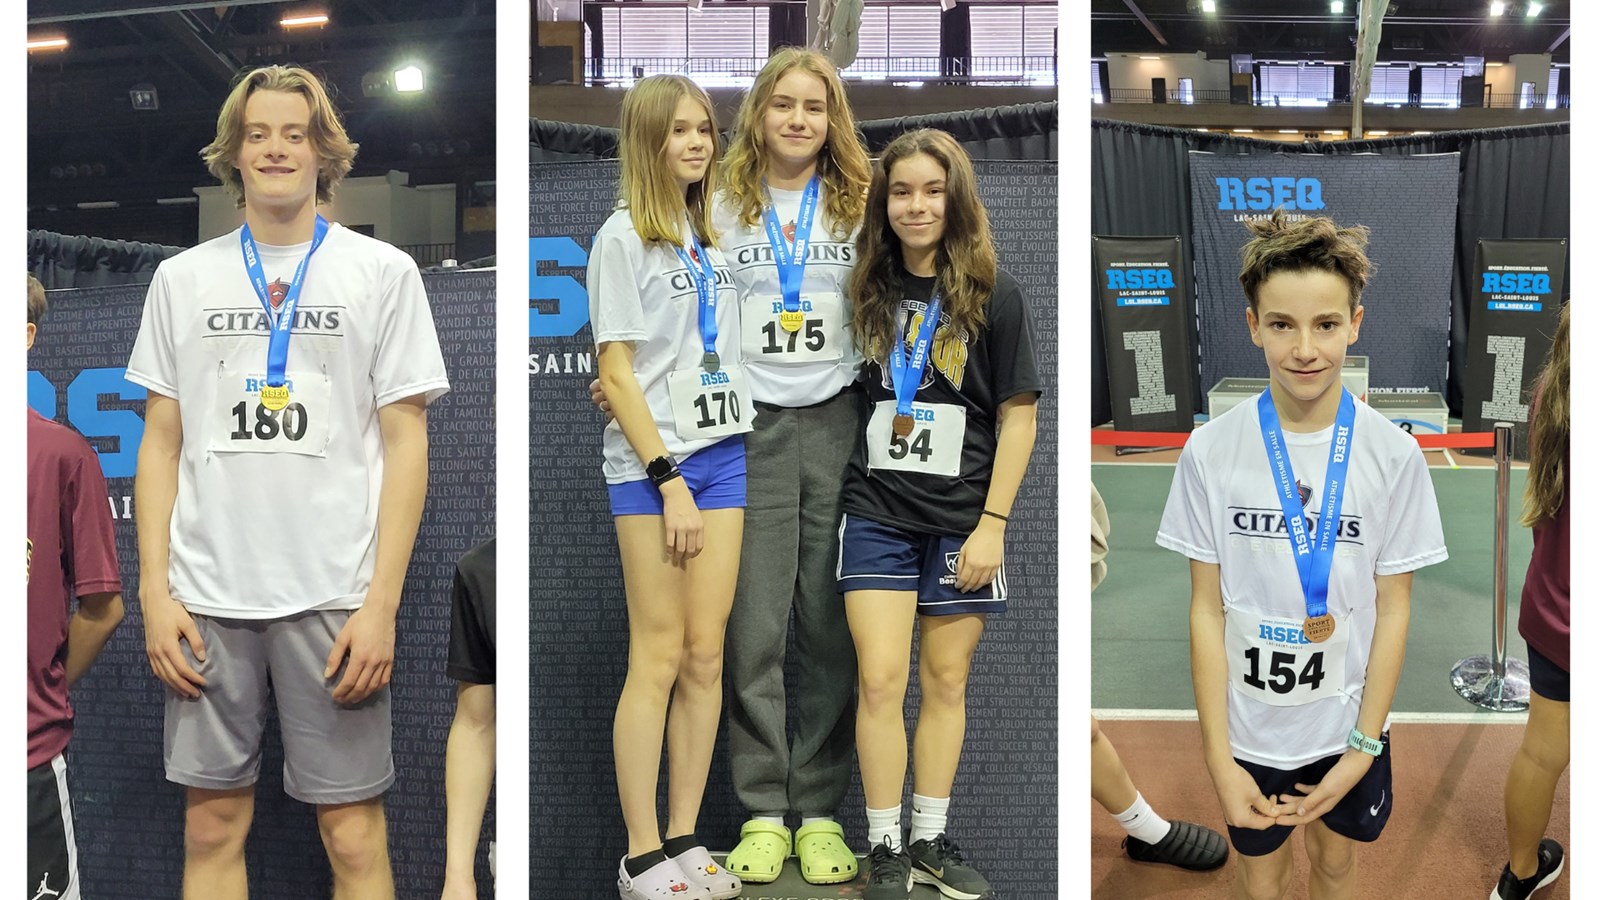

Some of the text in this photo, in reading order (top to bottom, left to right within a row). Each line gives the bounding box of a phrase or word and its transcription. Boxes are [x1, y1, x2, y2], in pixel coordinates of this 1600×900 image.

[541, 168, 598, 180] DÉPASSEMENT
[989, 164, 1045, 174] ENGAGEMENT
[1010, 176, 1038, 184] DE SOI
[535, 182, 548, 192] SOI
[1032, 187, 1046, 196] SKI
[1215, 178, 1326, 210] RSEQ
[560, 203, 586, 213] FORCE
[994, 218, 1052, 230] DÉPASSEMENT
[245, 239, 256, 268] RSEQ
[794, 240, 806, 266] RSEQ
[1004, 254, 1030, 262] FORCE
[1105, 269, 1176, 290] RSEQ
[1482, 272, 1552, 294] RSEQ
[280, 299, 294, 331] RSEQ
[56, 344, 107, 355] BASKETBALL
[912, 340, 928, 369] RSEQ
[68, 355, 108, 368] NATATION
[1122, 330, 1176, 416] 1
[540, 378, 585, 388] ENJOYMENT
[700, 372, 730, 386] RSEQ
[1481, 335, 1530, 422] 1
[533, 390, 572, 400] FOOTBALL
[456, 395, 486, 406] COACH
[556, 402, 594, 411] SCOLAIRE
[694, 390, 740, 428] 170
[455, 408, 494, 418] FAMILLE
[536, 412, 592, 422] RACCROCHAGE
[231, 401, 308, 441] 180
[533, 424, 600, 434] SUCCESS JEUNES
[550, 434, 575, 444] SANTÉ
[1268, 430, 1280, 450] SALLE
[562, 444, 592, 456] SUCCÈS
[888, 428, 933, 462] 54
[1334, 426, 1349, 464] RSEQ
[458, 445, 486, 457] SANTÉ
[1276, 449, 1282, 459] EN
[430, 460, 484, 470] BELONGING
[532, 468, 580, 479] VOLLEYBALL
[562, 478, 602, 490] INTÉGRITÉ
[544, 492, 578, 501] STUDENT
[1027, 486, 1052, 497] SANTÉ
[438, 496, 486, 509] INTÉGRITÉ
[436, 511, 476, 522] PASSION
[1320, 480, 1338, 551] ATHLÉTISME EN SALLE
[548, 524, 592, 534] CONSTANCE
[542, 534, 611, 545] RÉSEAU ÉTHIQUE
[1290, 514, 1310, 556] RSEQ
[426, 538, 465, 549] STUDIES
[1014, 542, 1048, 552] PASSION
[557, 546, 616, 556] APPARTENANCE
[554, 556, 584, 566] VALUES
[534, 568, 567, 577] VICTORY
[1026, 564, 1056, 574] ÉTOILES
[992, 663, 1056, 674] ÉTUDIANT GALA
[1244, 646, 1326, 694] 154
[1009, 676, 1041, 686] SERVICE
[969, 686, 1030, 696] CHEERLEADING
[990, 698, 1034, 707] STRUCTURE
[1002, 708, 1047, 718] DISCIPLINE
[995, 720, 1026, 729] SABLON
[1020, 730, 1048, 740] VISION
[998, 742, 1048, 751] SOCCER BOL
[1009, 752, 1040, 762] HOCKEY
[1023, 761, 1054, 773] RÉSEAU
[980, 774, 1028, 784] MOTIVATION
[973, 786, 1020, 795] DYNAMIQUE
[986, 806, 1040, 816] DEVELOPMENT
[982, 818, 1033, 827] ENGAGEMENT
[1002, 829, 1012, 838] DE
[1014, 829, 1028, 838] SOI
[1024, 840, 1036, 849] SKI
[978, 860, 1032, 870] ENCADREMENT
[988, 870, 1044, 881] DÉPASSEMENT
